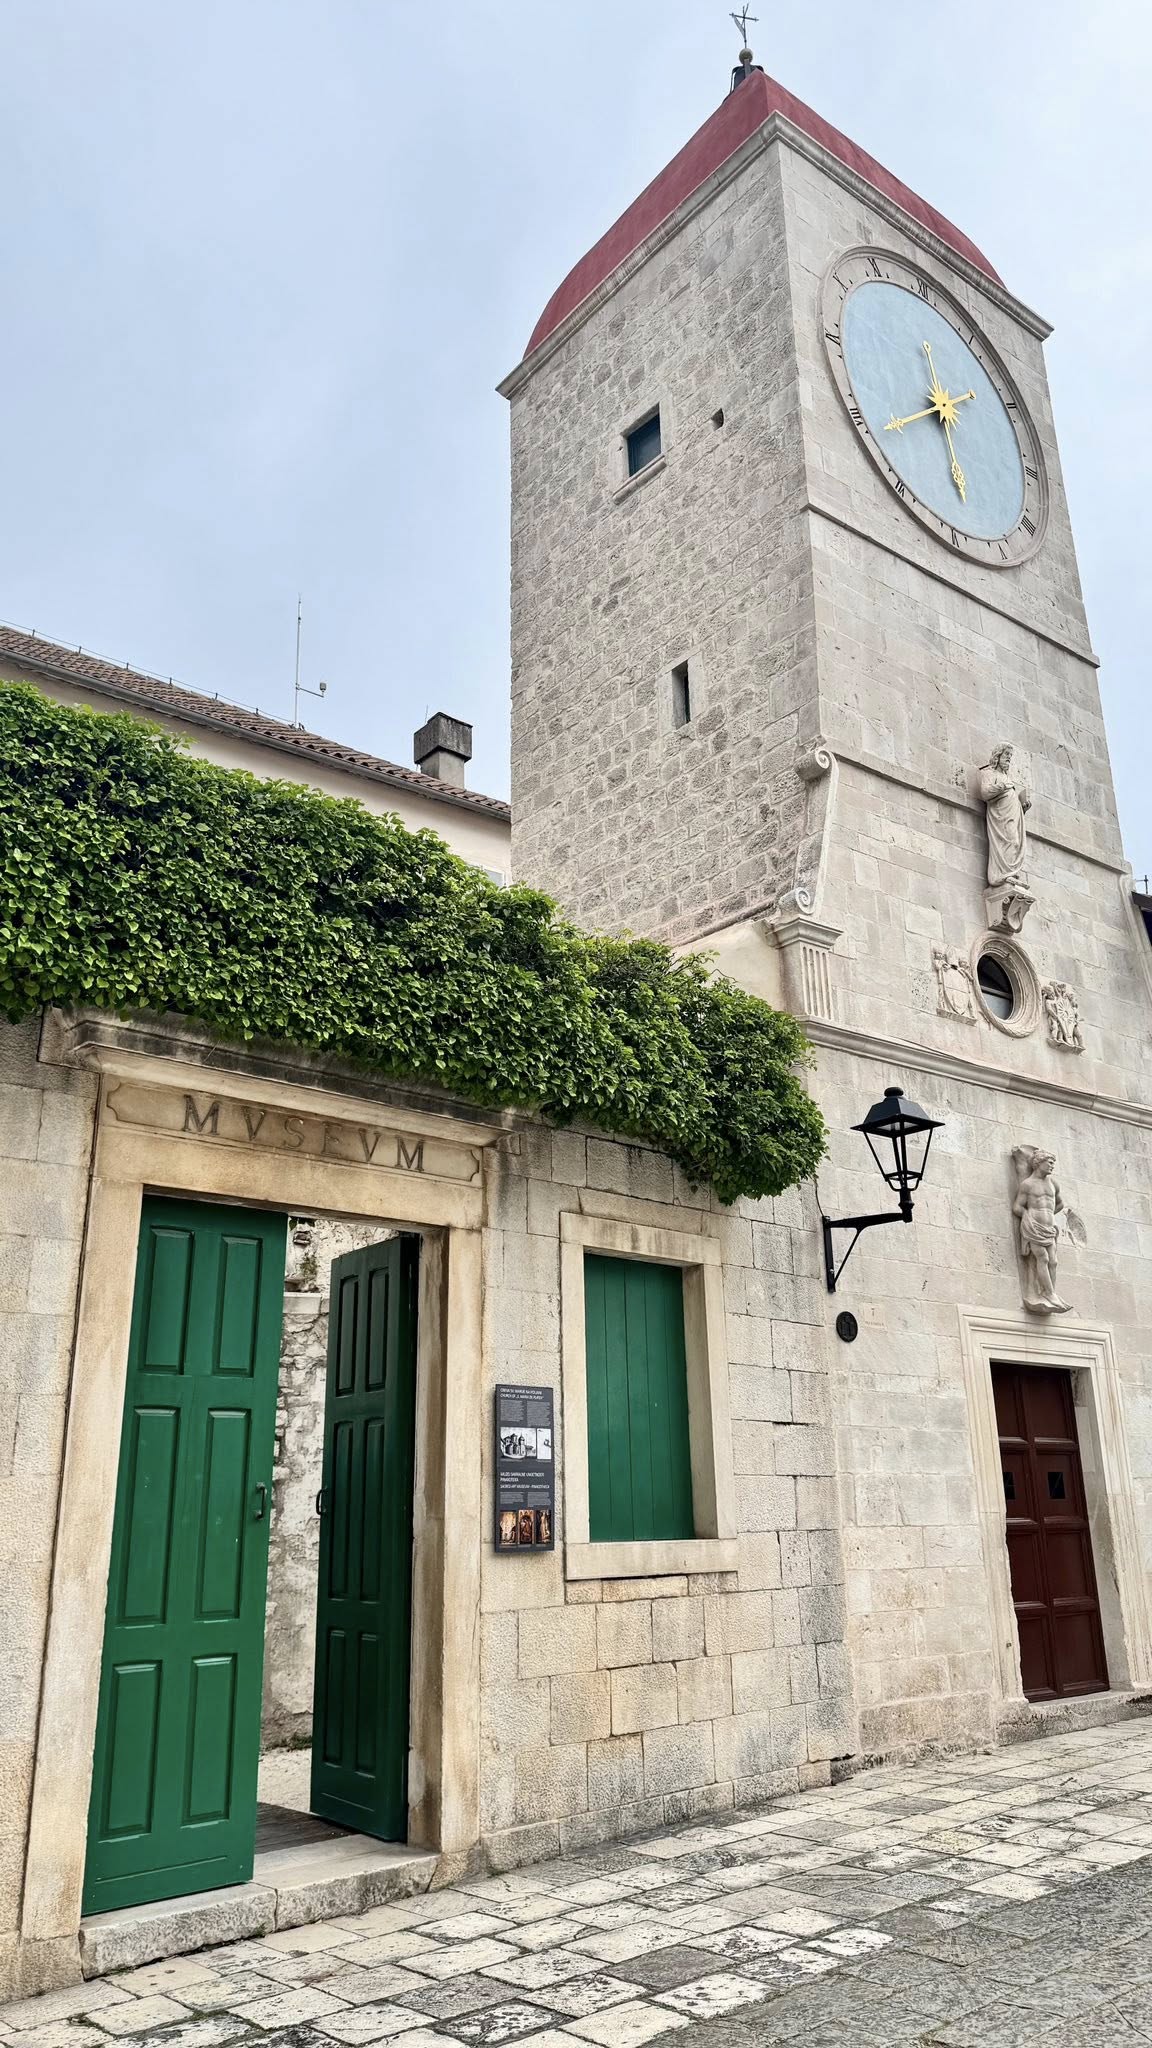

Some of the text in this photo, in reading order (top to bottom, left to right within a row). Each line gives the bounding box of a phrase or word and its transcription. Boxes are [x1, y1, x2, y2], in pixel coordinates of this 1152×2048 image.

[916, 277, 930, 301] XII
[849, 407, 864, 427] VIII
[1025, 466, 1038, 481] III
[894, 480, 905, 498] VII
[1020, 514, 1037, 537] IIII
[180, 1093, 425, 1173] MVSEVM
